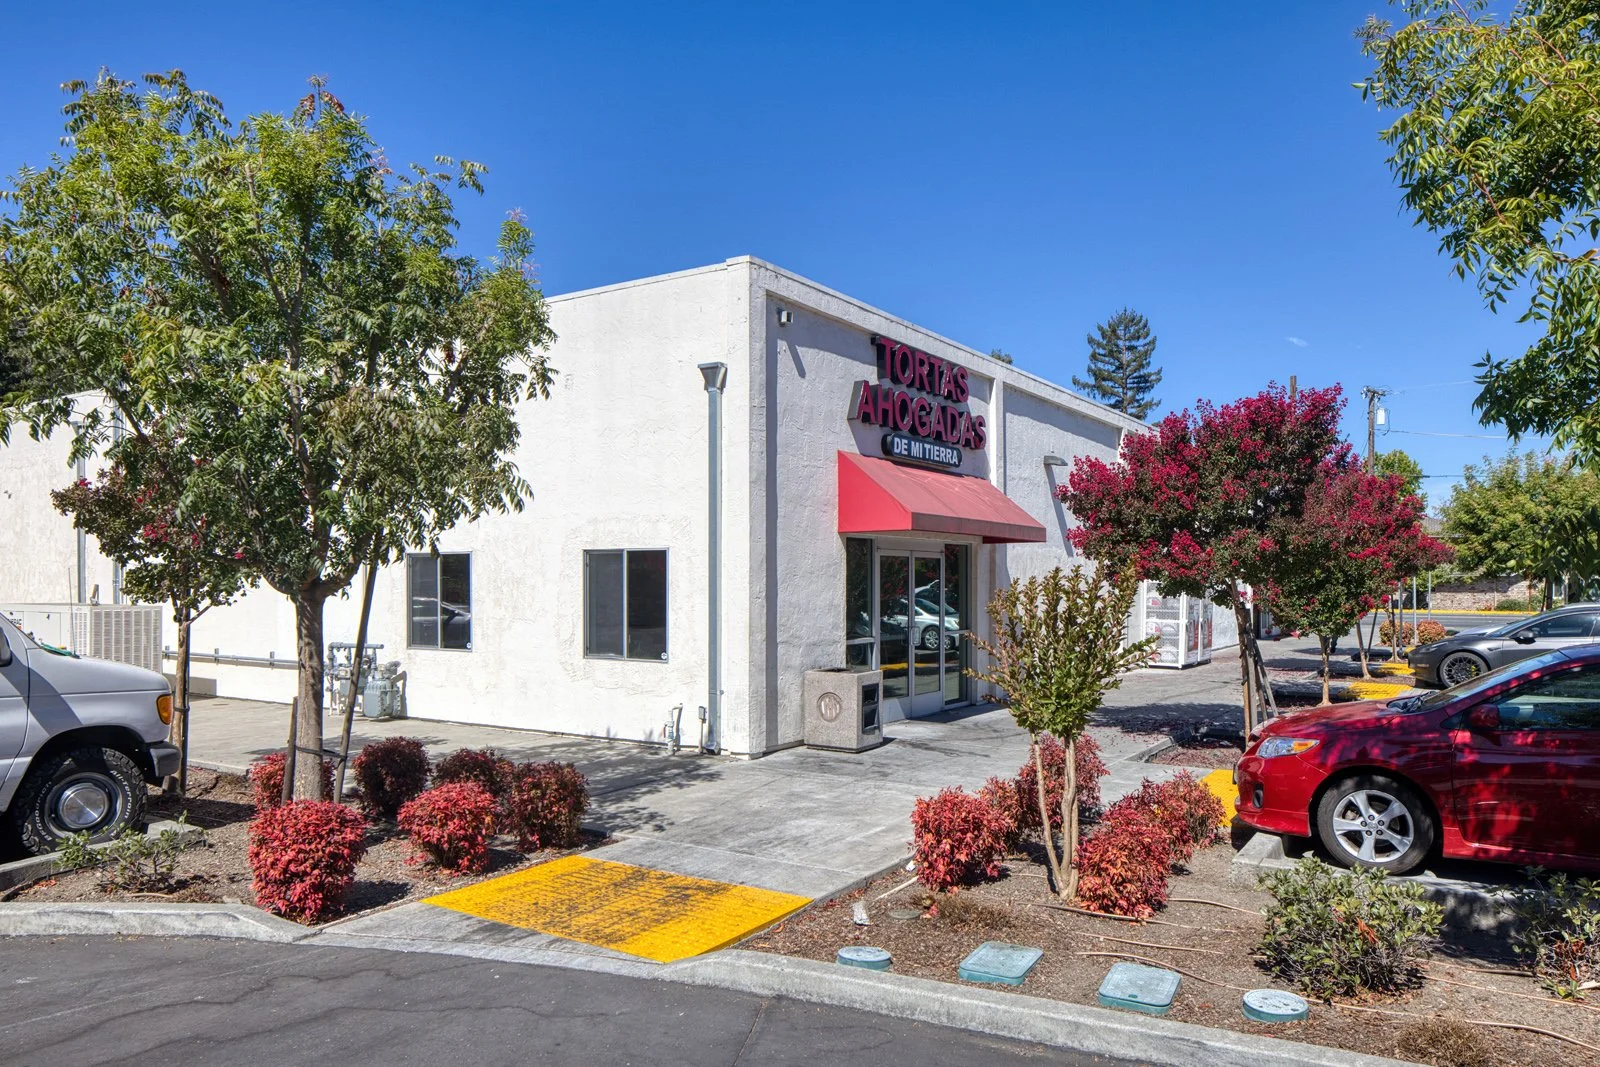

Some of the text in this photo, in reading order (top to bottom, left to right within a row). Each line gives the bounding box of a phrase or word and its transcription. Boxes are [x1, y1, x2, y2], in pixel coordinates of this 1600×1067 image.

[879, 336, 969, 403] TORTAS
[856, 380, 987, 450] AHOGADAS
[893, 437, 959, 465] DE MI TIERRA
